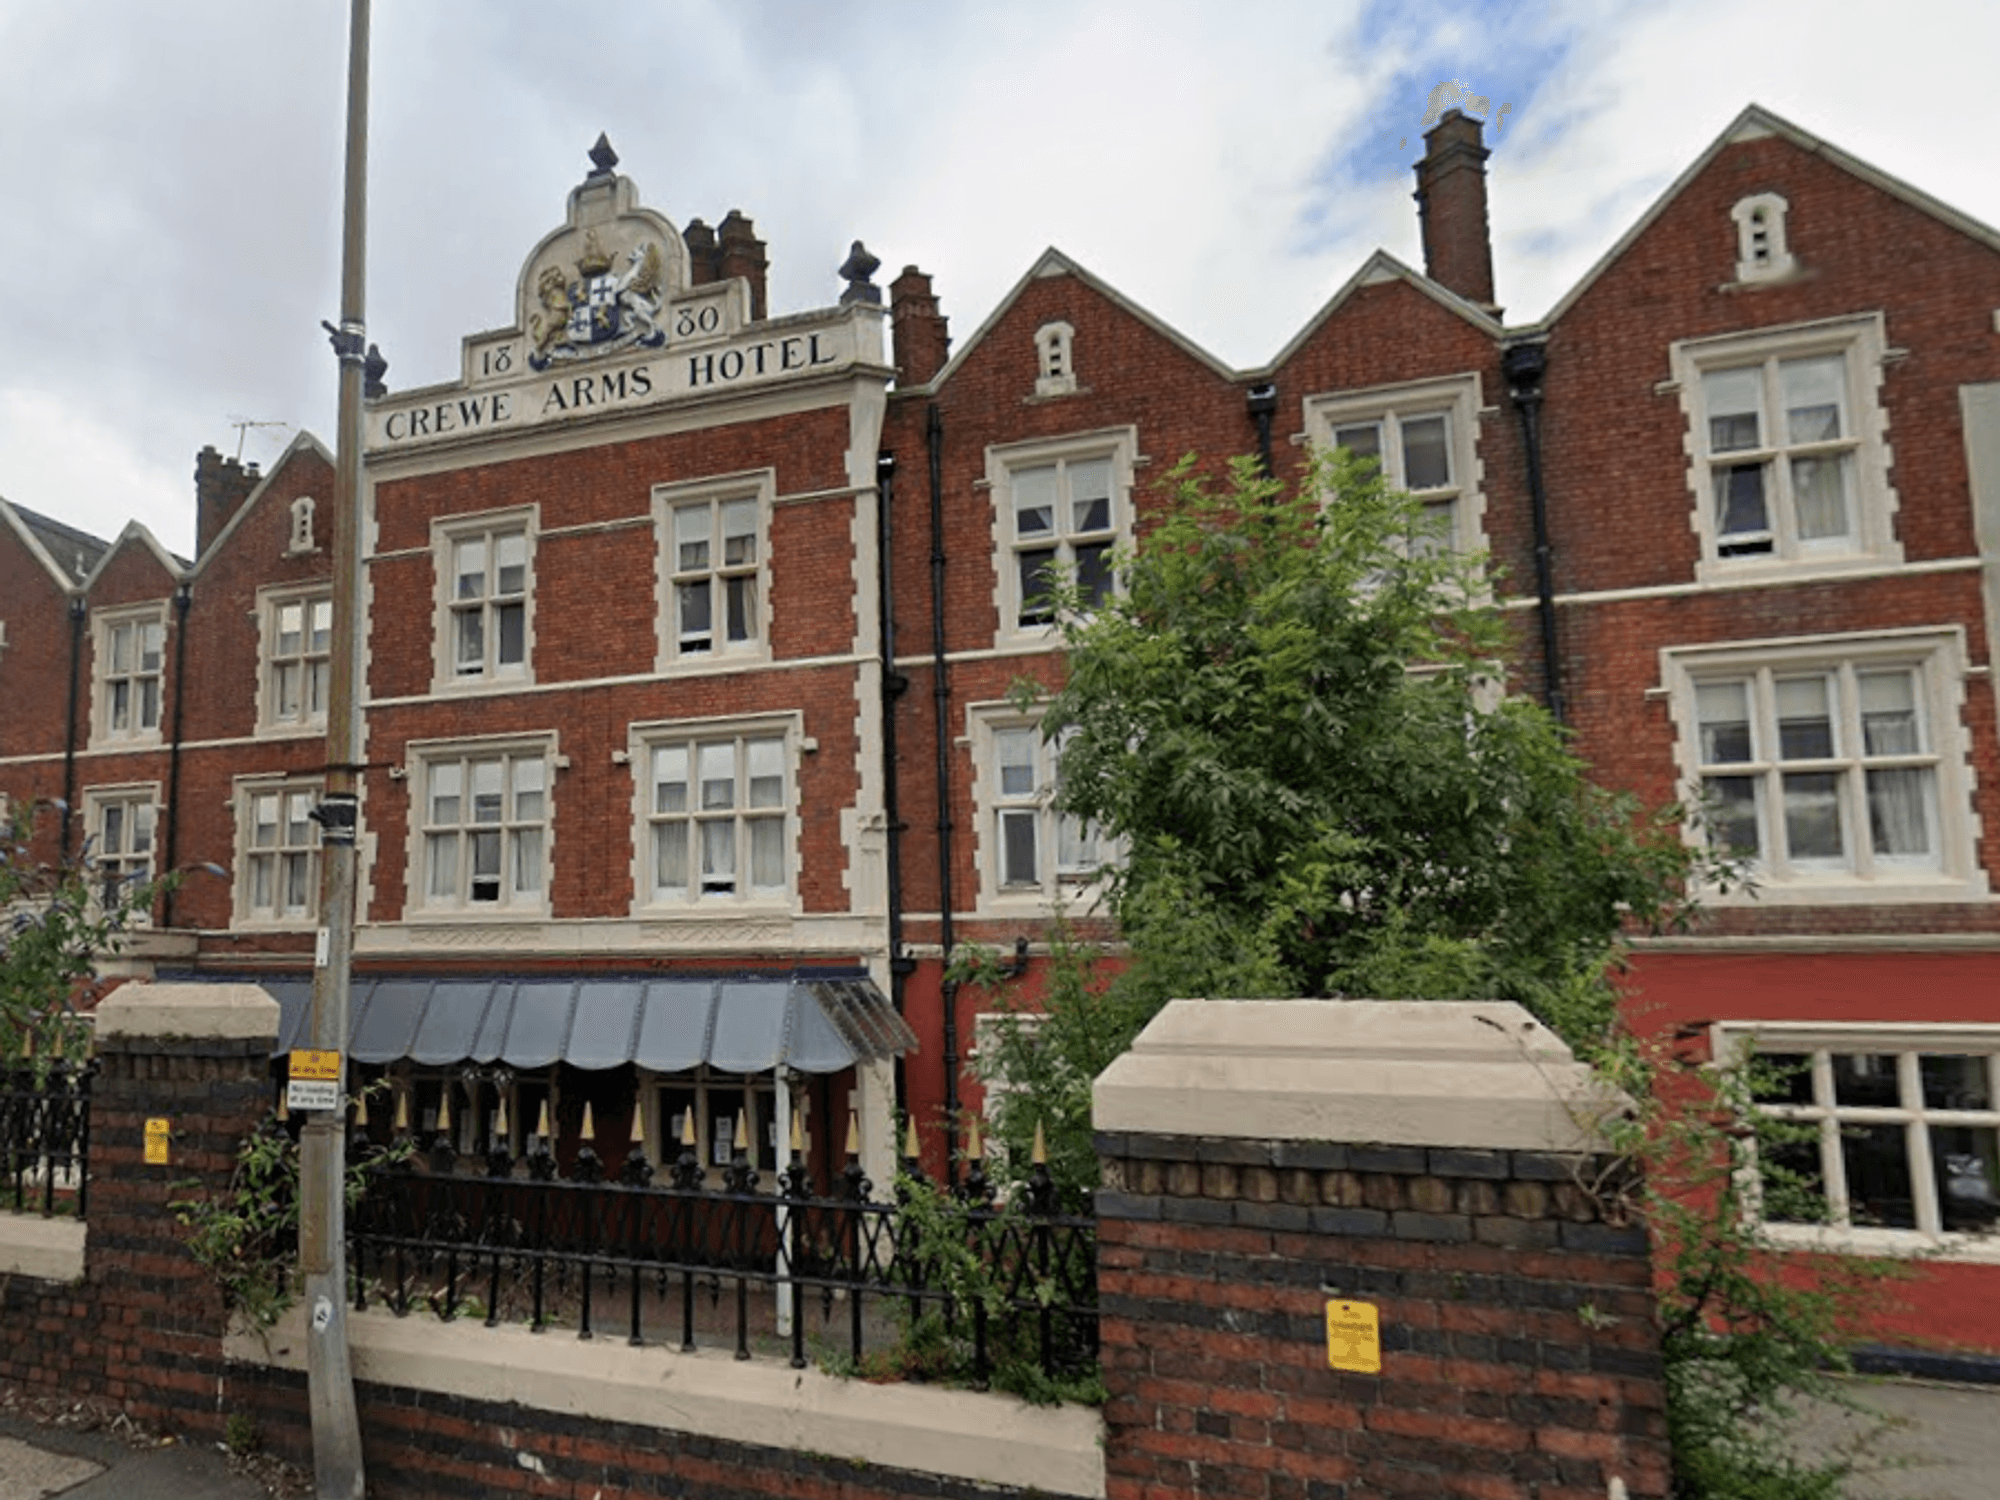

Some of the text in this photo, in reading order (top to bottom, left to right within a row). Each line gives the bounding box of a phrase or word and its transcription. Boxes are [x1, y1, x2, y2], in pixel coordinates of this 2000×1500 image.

[677, 305, 719, 337] 80
[483, 344, 513, 377] 18
[385, 333, 837, 441] CREWE ARMS HOTEL
